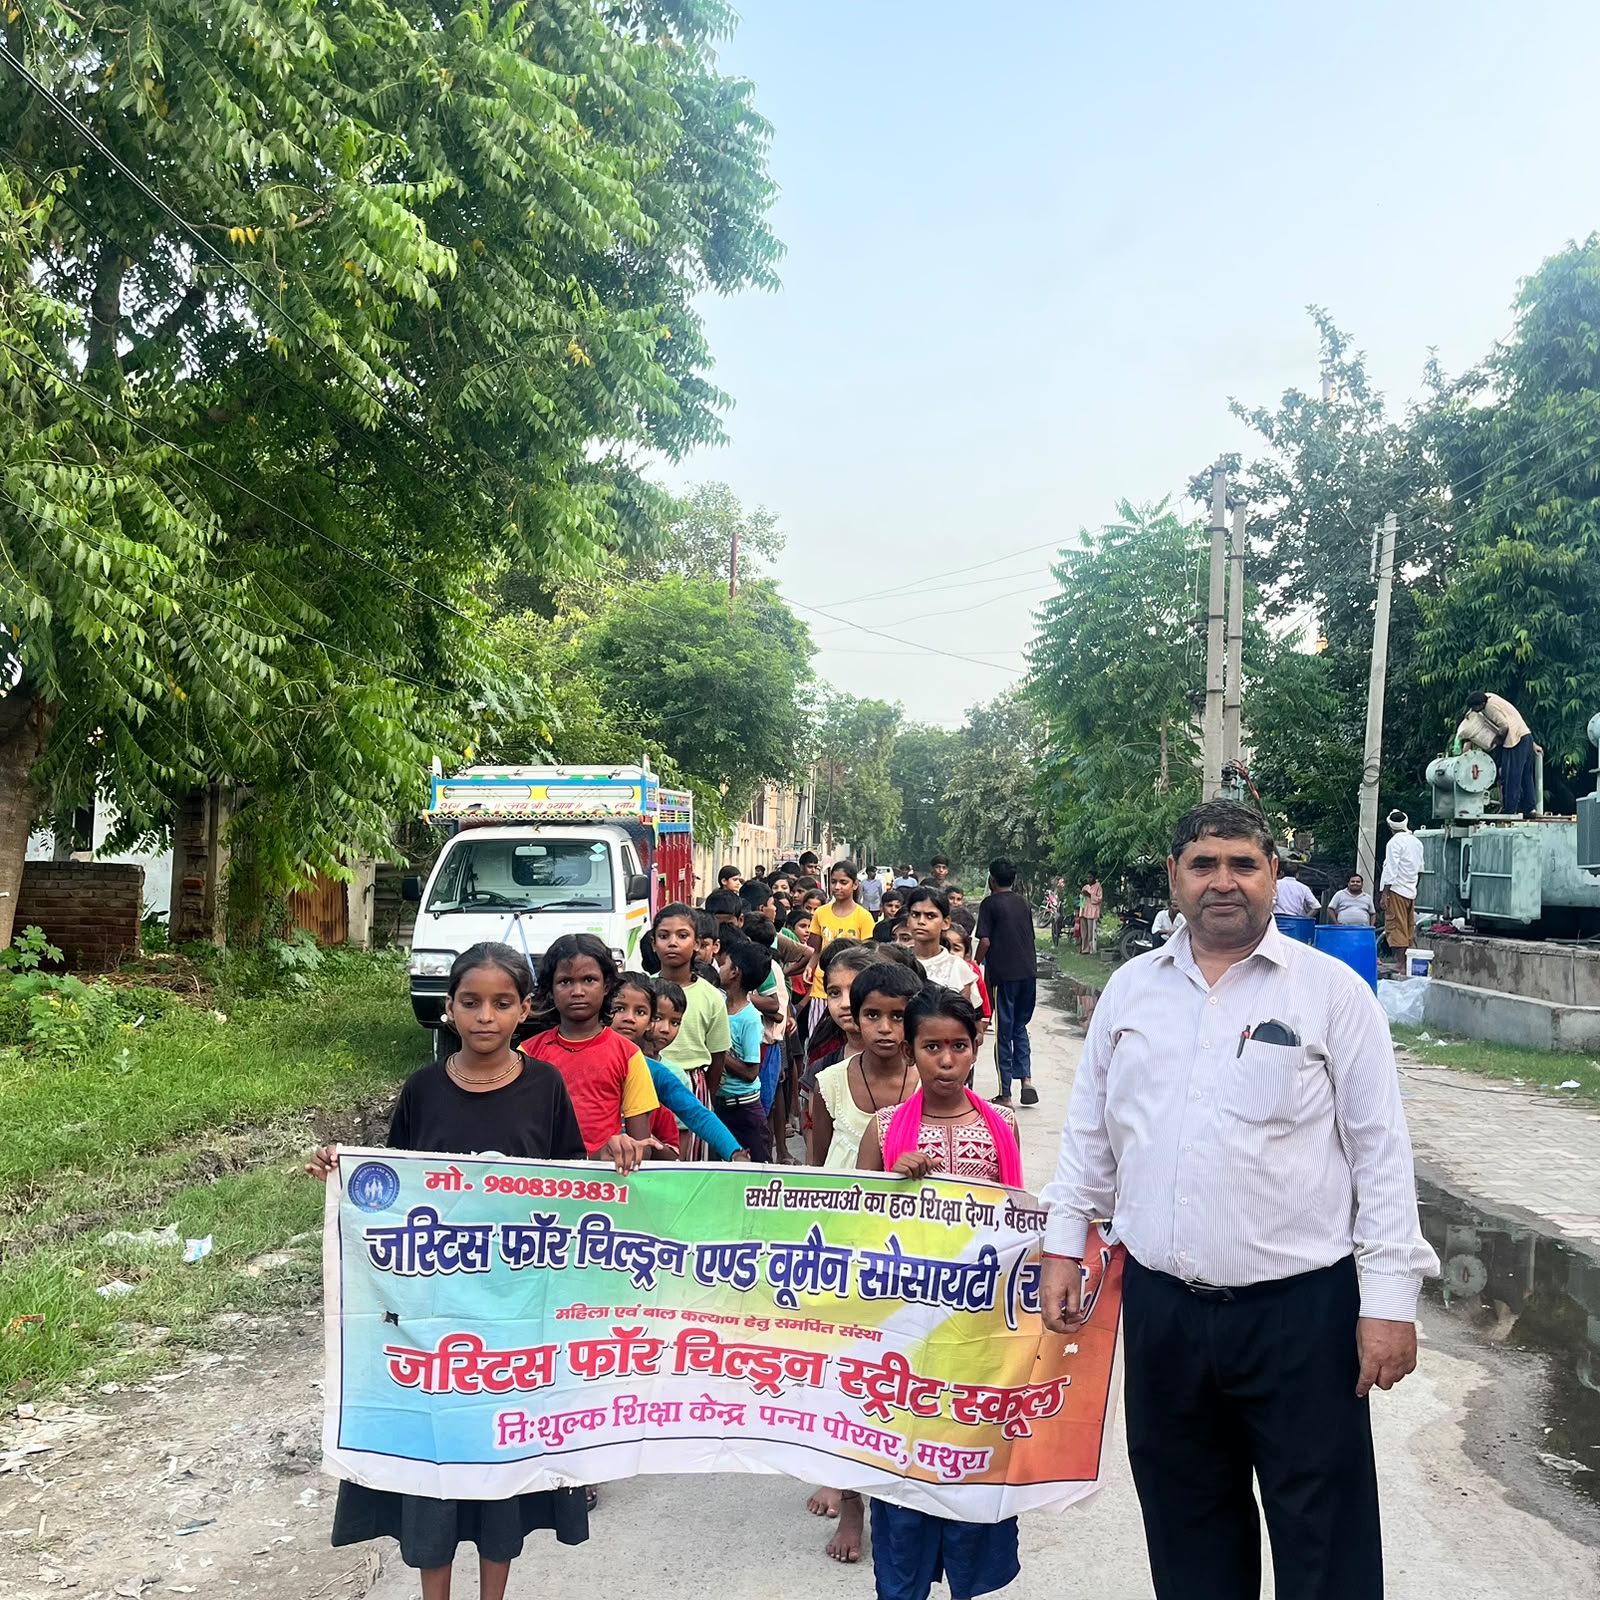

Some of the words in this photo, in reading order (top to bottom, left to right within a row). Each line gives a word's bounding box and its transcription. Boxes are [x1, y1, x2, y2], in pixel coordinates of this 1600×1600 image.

[483, 1174, 629, 1204] 9808393831
[746, 1180, 782, 1208] सभी
[784, 1185, 862, 1211] समस्याओ
[865, 1192, 887, 1213] का
[890, 1193, 917, 1219] हल
[920, 1189, 962, 1222] शिक्षा
[365, 1207, 494, 1273] जस्टिस
[500, 1213, 573, 1268] फॉर
[577, 1214, 688, 1288] चिल्ड्रन
[694, 1240, 764, 1287] एण्ड
[768, 1224, 852, 1307] वूमैन
[858, 1236, 1001, 1311] सोसायटी
[556, 1303, 610, 1319] महिला
[614, 1303, 642, 1318] एवं
[681, 1310, 740, 1325] कल्याण
[744, 1315, 771, 1331] हेतु
[775, 1318, 835, 1334] समर्पित
[839, 1323, 883, 1342] संस्था
[386, 1334, 557, 1392] जस्टिस
[569, 1326, 665, 1377] फॉर
[674, 1330, 829, 1395] चिल्ड्रन
[839, 1352, 945, 1422] स्ट्रीट
[952, 1376, 1070, 1438] स्कूल
[613, 1394, 683, 1427] शिक्षा
[689, 1393, 746, 1426] केन्द्र
[759, 1405, 814, 1432] पन्ना
[918, 1441, 988, 1478] मथुरा
